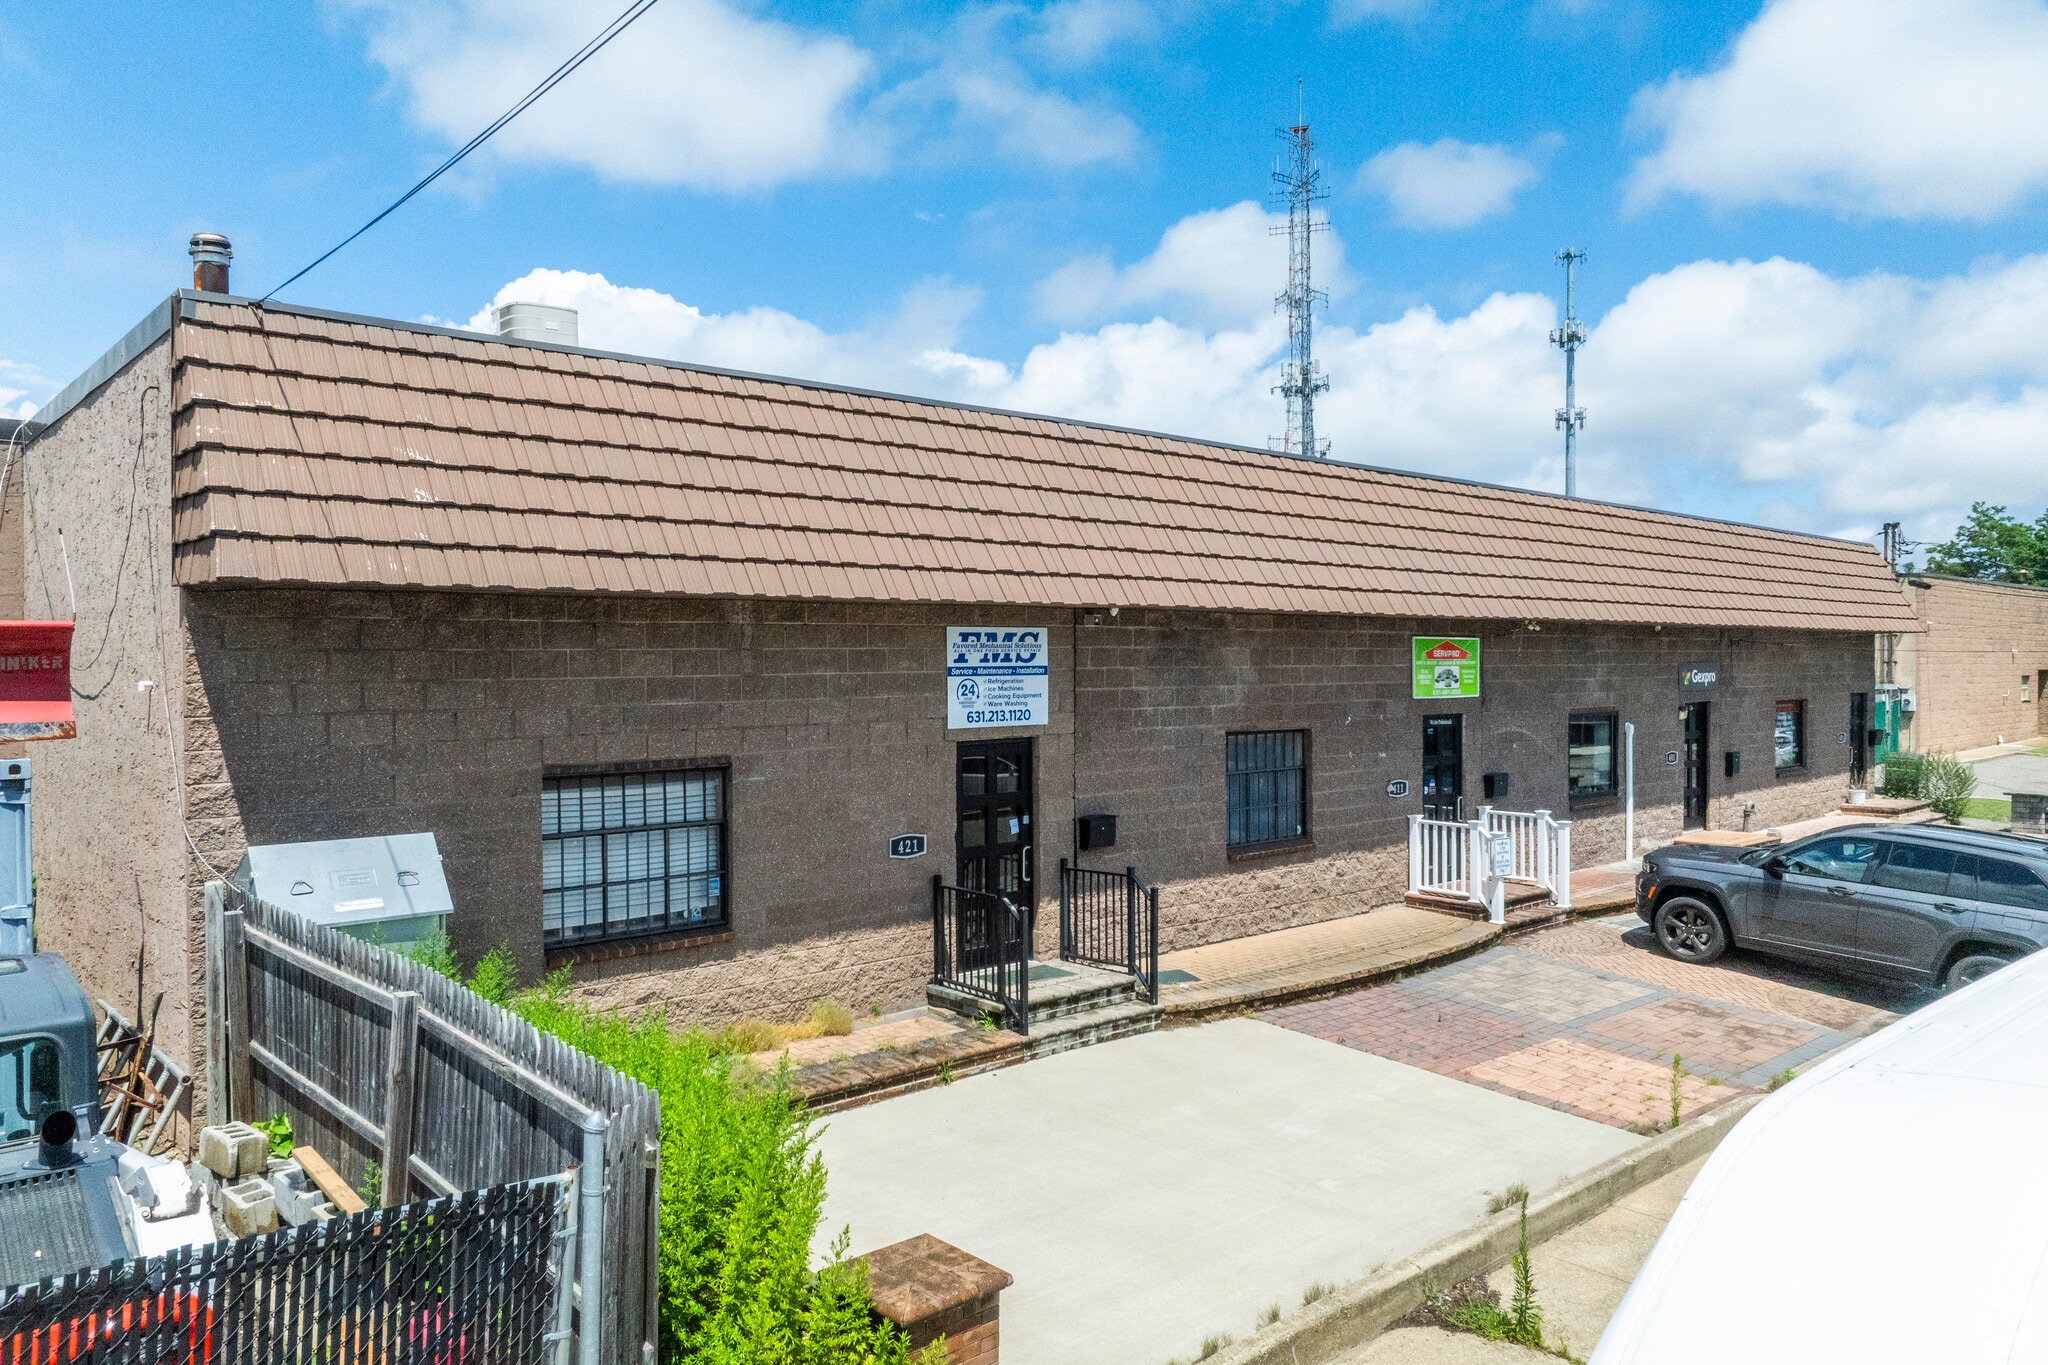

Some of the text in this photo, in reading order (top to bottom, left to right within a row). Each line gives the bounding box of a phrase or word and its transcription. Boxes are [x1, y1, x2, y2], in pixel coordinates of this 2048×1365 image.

[953, 632, 1040, 664] FMS
[1433, 650, 1460, 658] SERVPRO
[1692, 670, 1716, 686] Gexpro
[960, 684, 976, 696] 24
[966, 708, 1031, 723] 631.213.1120
[898, 839, 918, 854] 421
